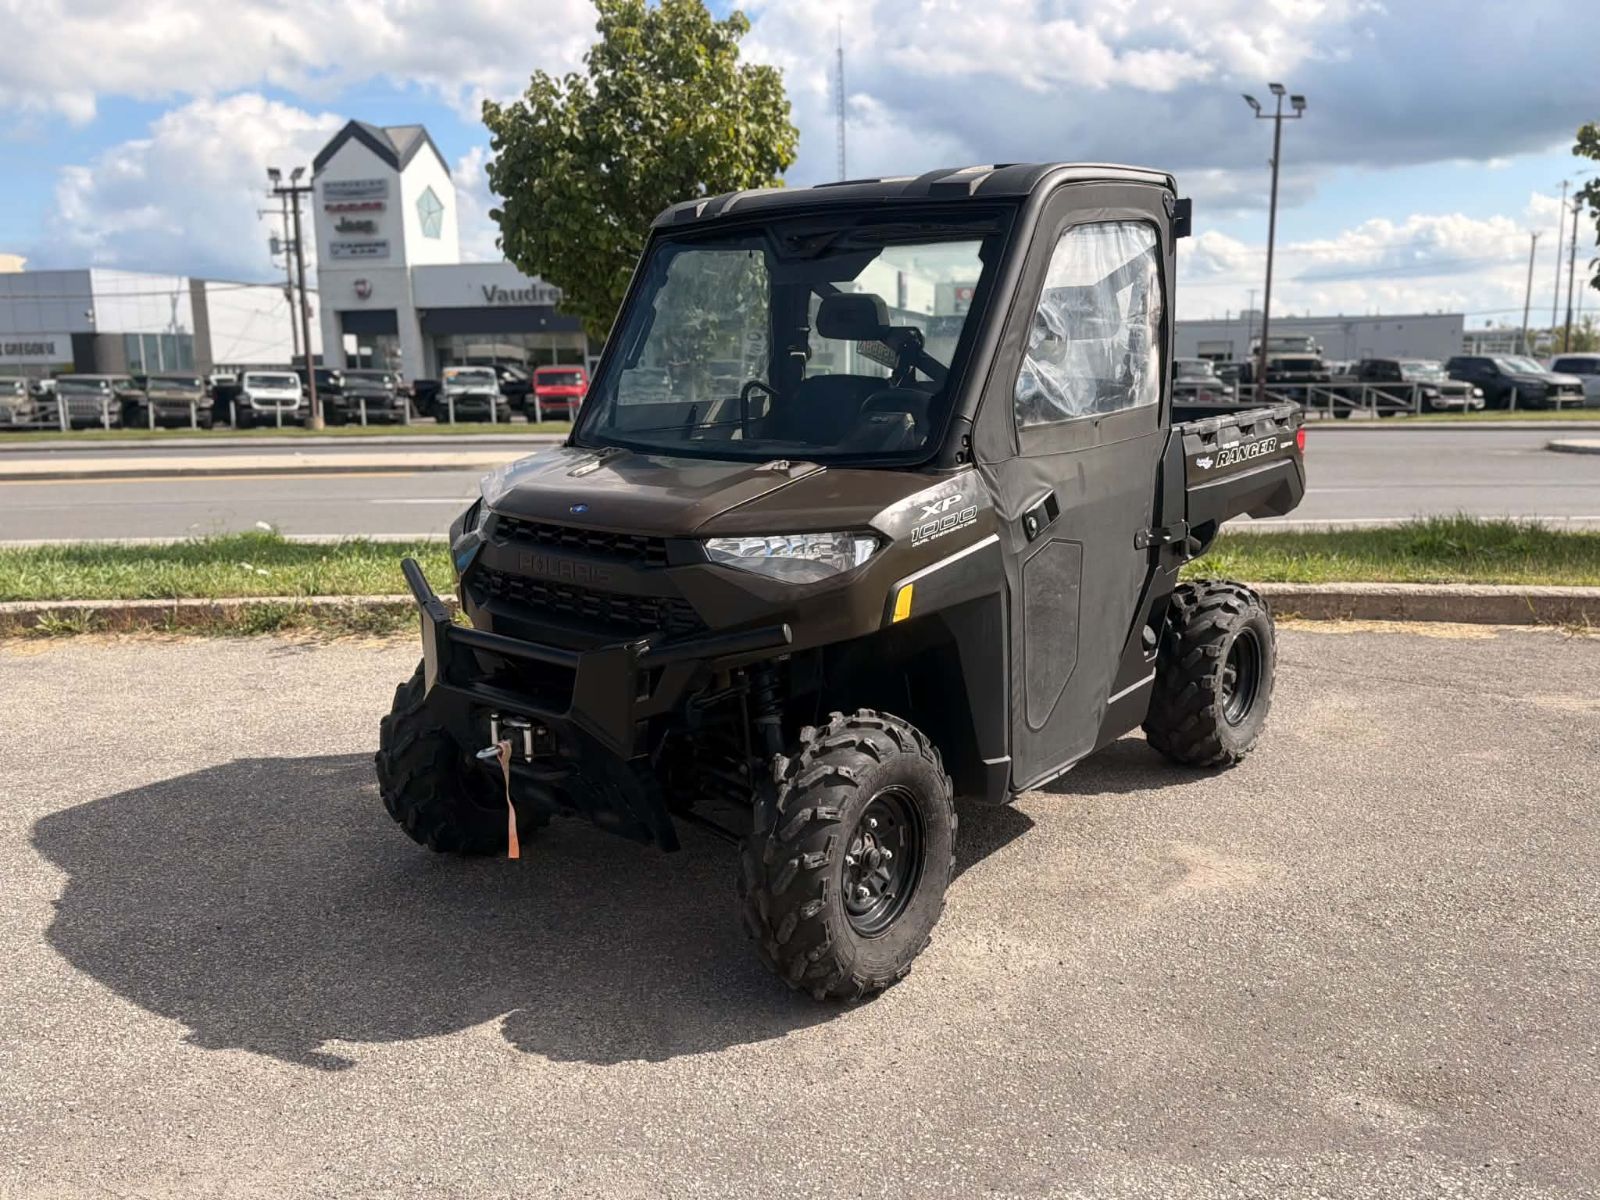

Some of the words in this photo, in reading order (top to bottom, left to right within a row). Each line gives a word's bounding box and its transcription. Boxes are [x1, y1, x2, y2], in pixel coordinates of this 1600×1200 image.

[334, 216, 375, 234] Jeep
[482, 284, 561, 302] Vaudre
[1216, 438, 1276, 468] RANGER
[919, 494, 962, 520] XP
[912, 505, 977, 542] 1000
[519, 550, 612, 583] POLARIS
